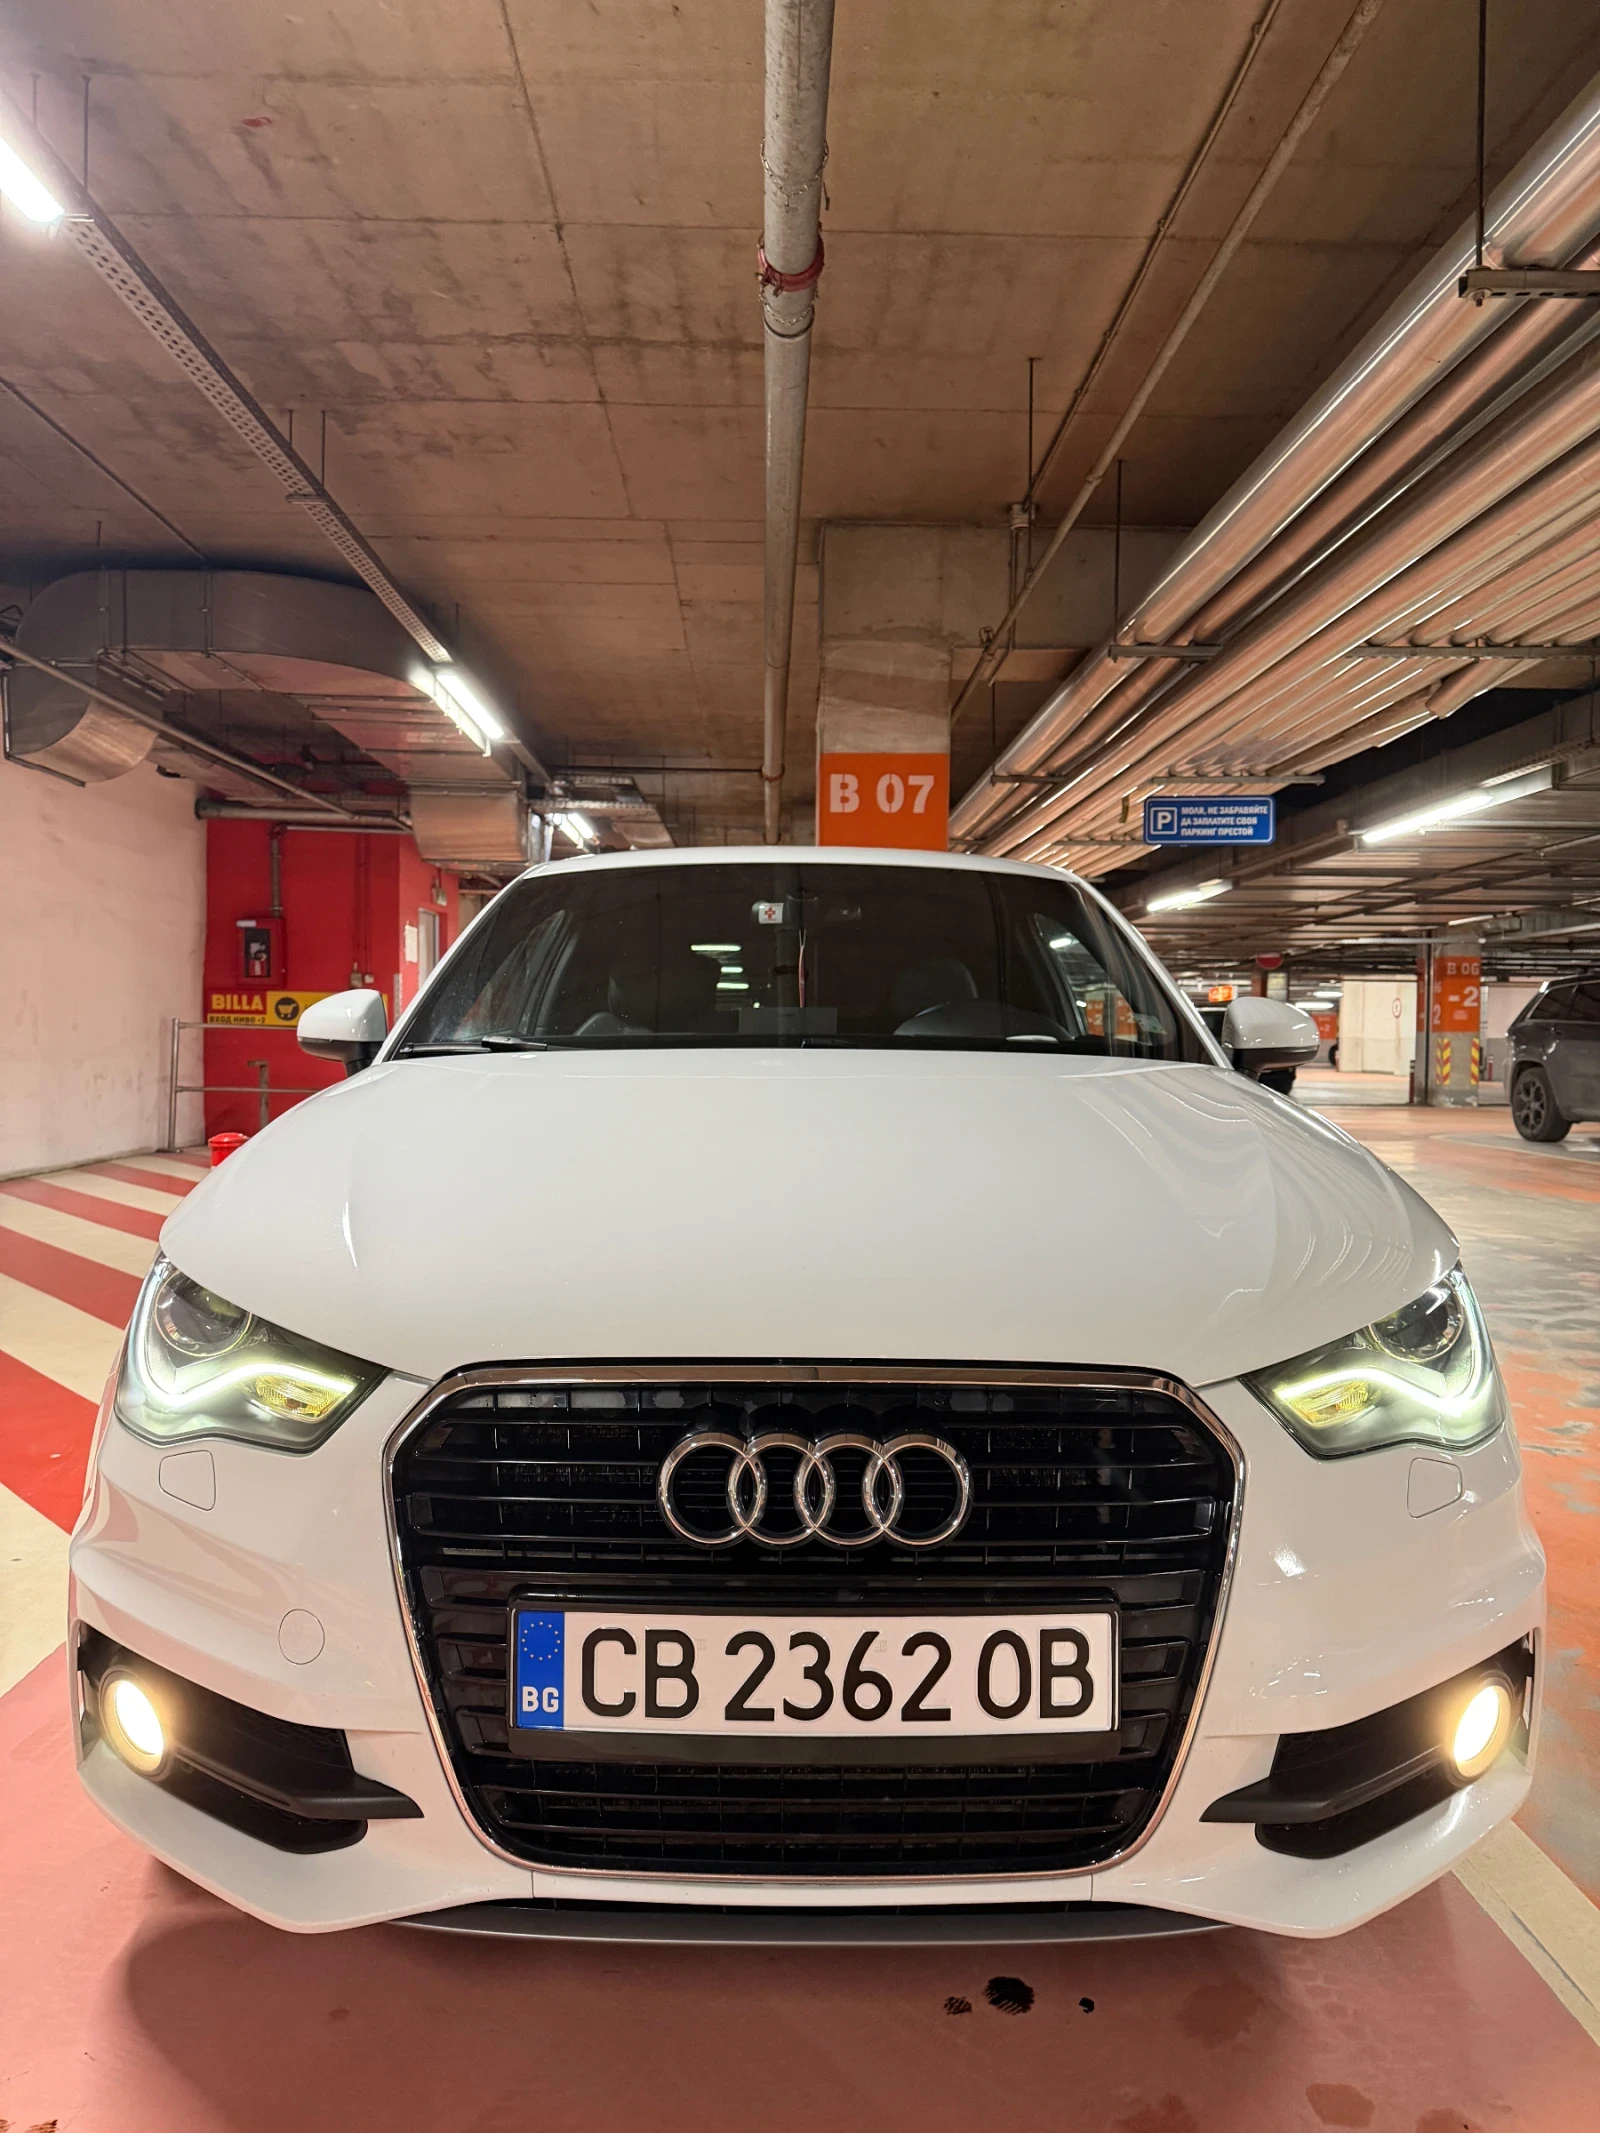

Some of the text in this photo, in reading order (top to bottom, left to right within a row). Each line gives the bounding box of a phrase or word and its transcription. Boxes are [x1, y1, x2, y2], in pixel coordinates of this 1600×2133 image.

[829, 773, 935, 814] B 07
[1207, 806, 1218, 814] НЕ
[1219, 804, 1268, 814] ЗАБРАВЯЙТЕ
[1157, 812, 1172, 830] P
[1181, 817, 1257, 826] ДА ЗАПЛАТИТЕ СВОЯ
[1181, 826, 1253, 836] ПАРКИНГ ПРЕСТОЙ
[1447, 962, 1480, 976] B 06
[211, 993, 264, 1011] BILLA
[1448, 986, 1479, 1007] -2
[209, 1015, 231, 1025] ВХОД
[581, 1627, 700, 1719] CB
[724, 1631, 952, 1722] 2362
[521, 1686, 560, 1714] BG
